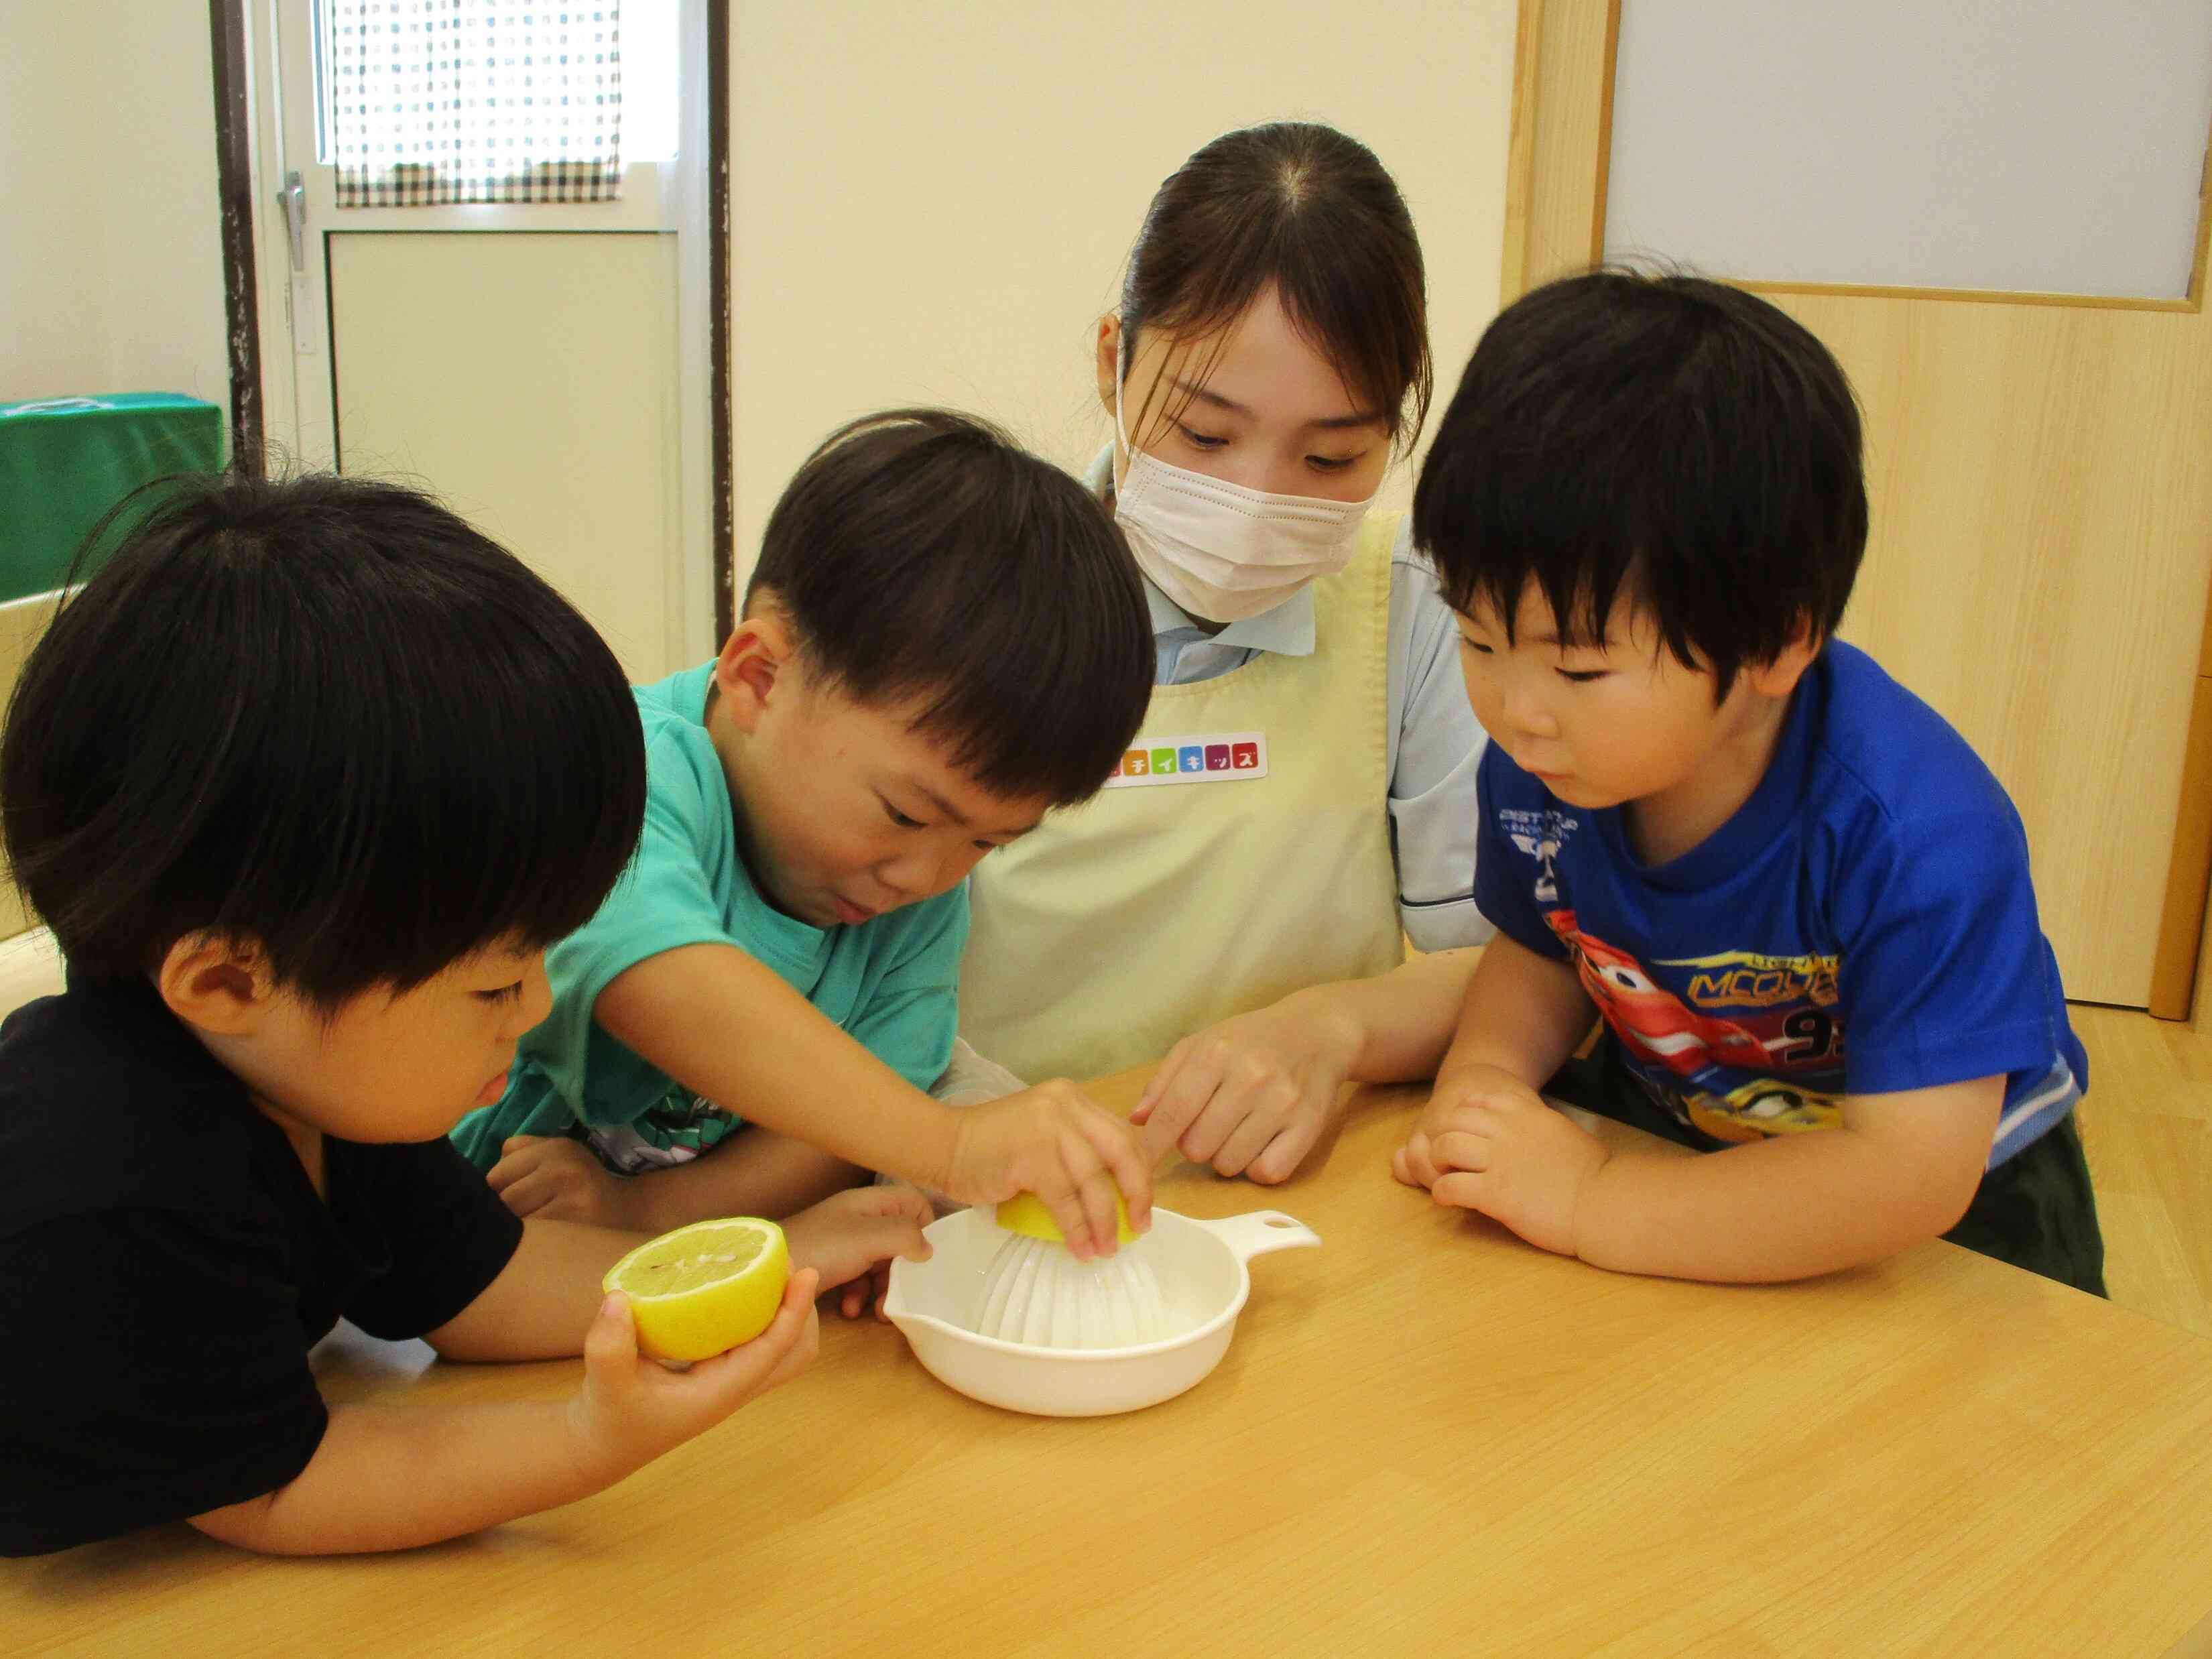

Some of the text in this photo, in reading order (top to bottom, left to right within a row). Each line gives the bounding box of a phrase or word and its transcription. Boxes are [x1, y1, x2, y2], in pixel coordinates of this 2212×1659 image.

[1113, 749, 1257, 775] チイキッズ
[1782, 1007, 1845, 1064] 9
